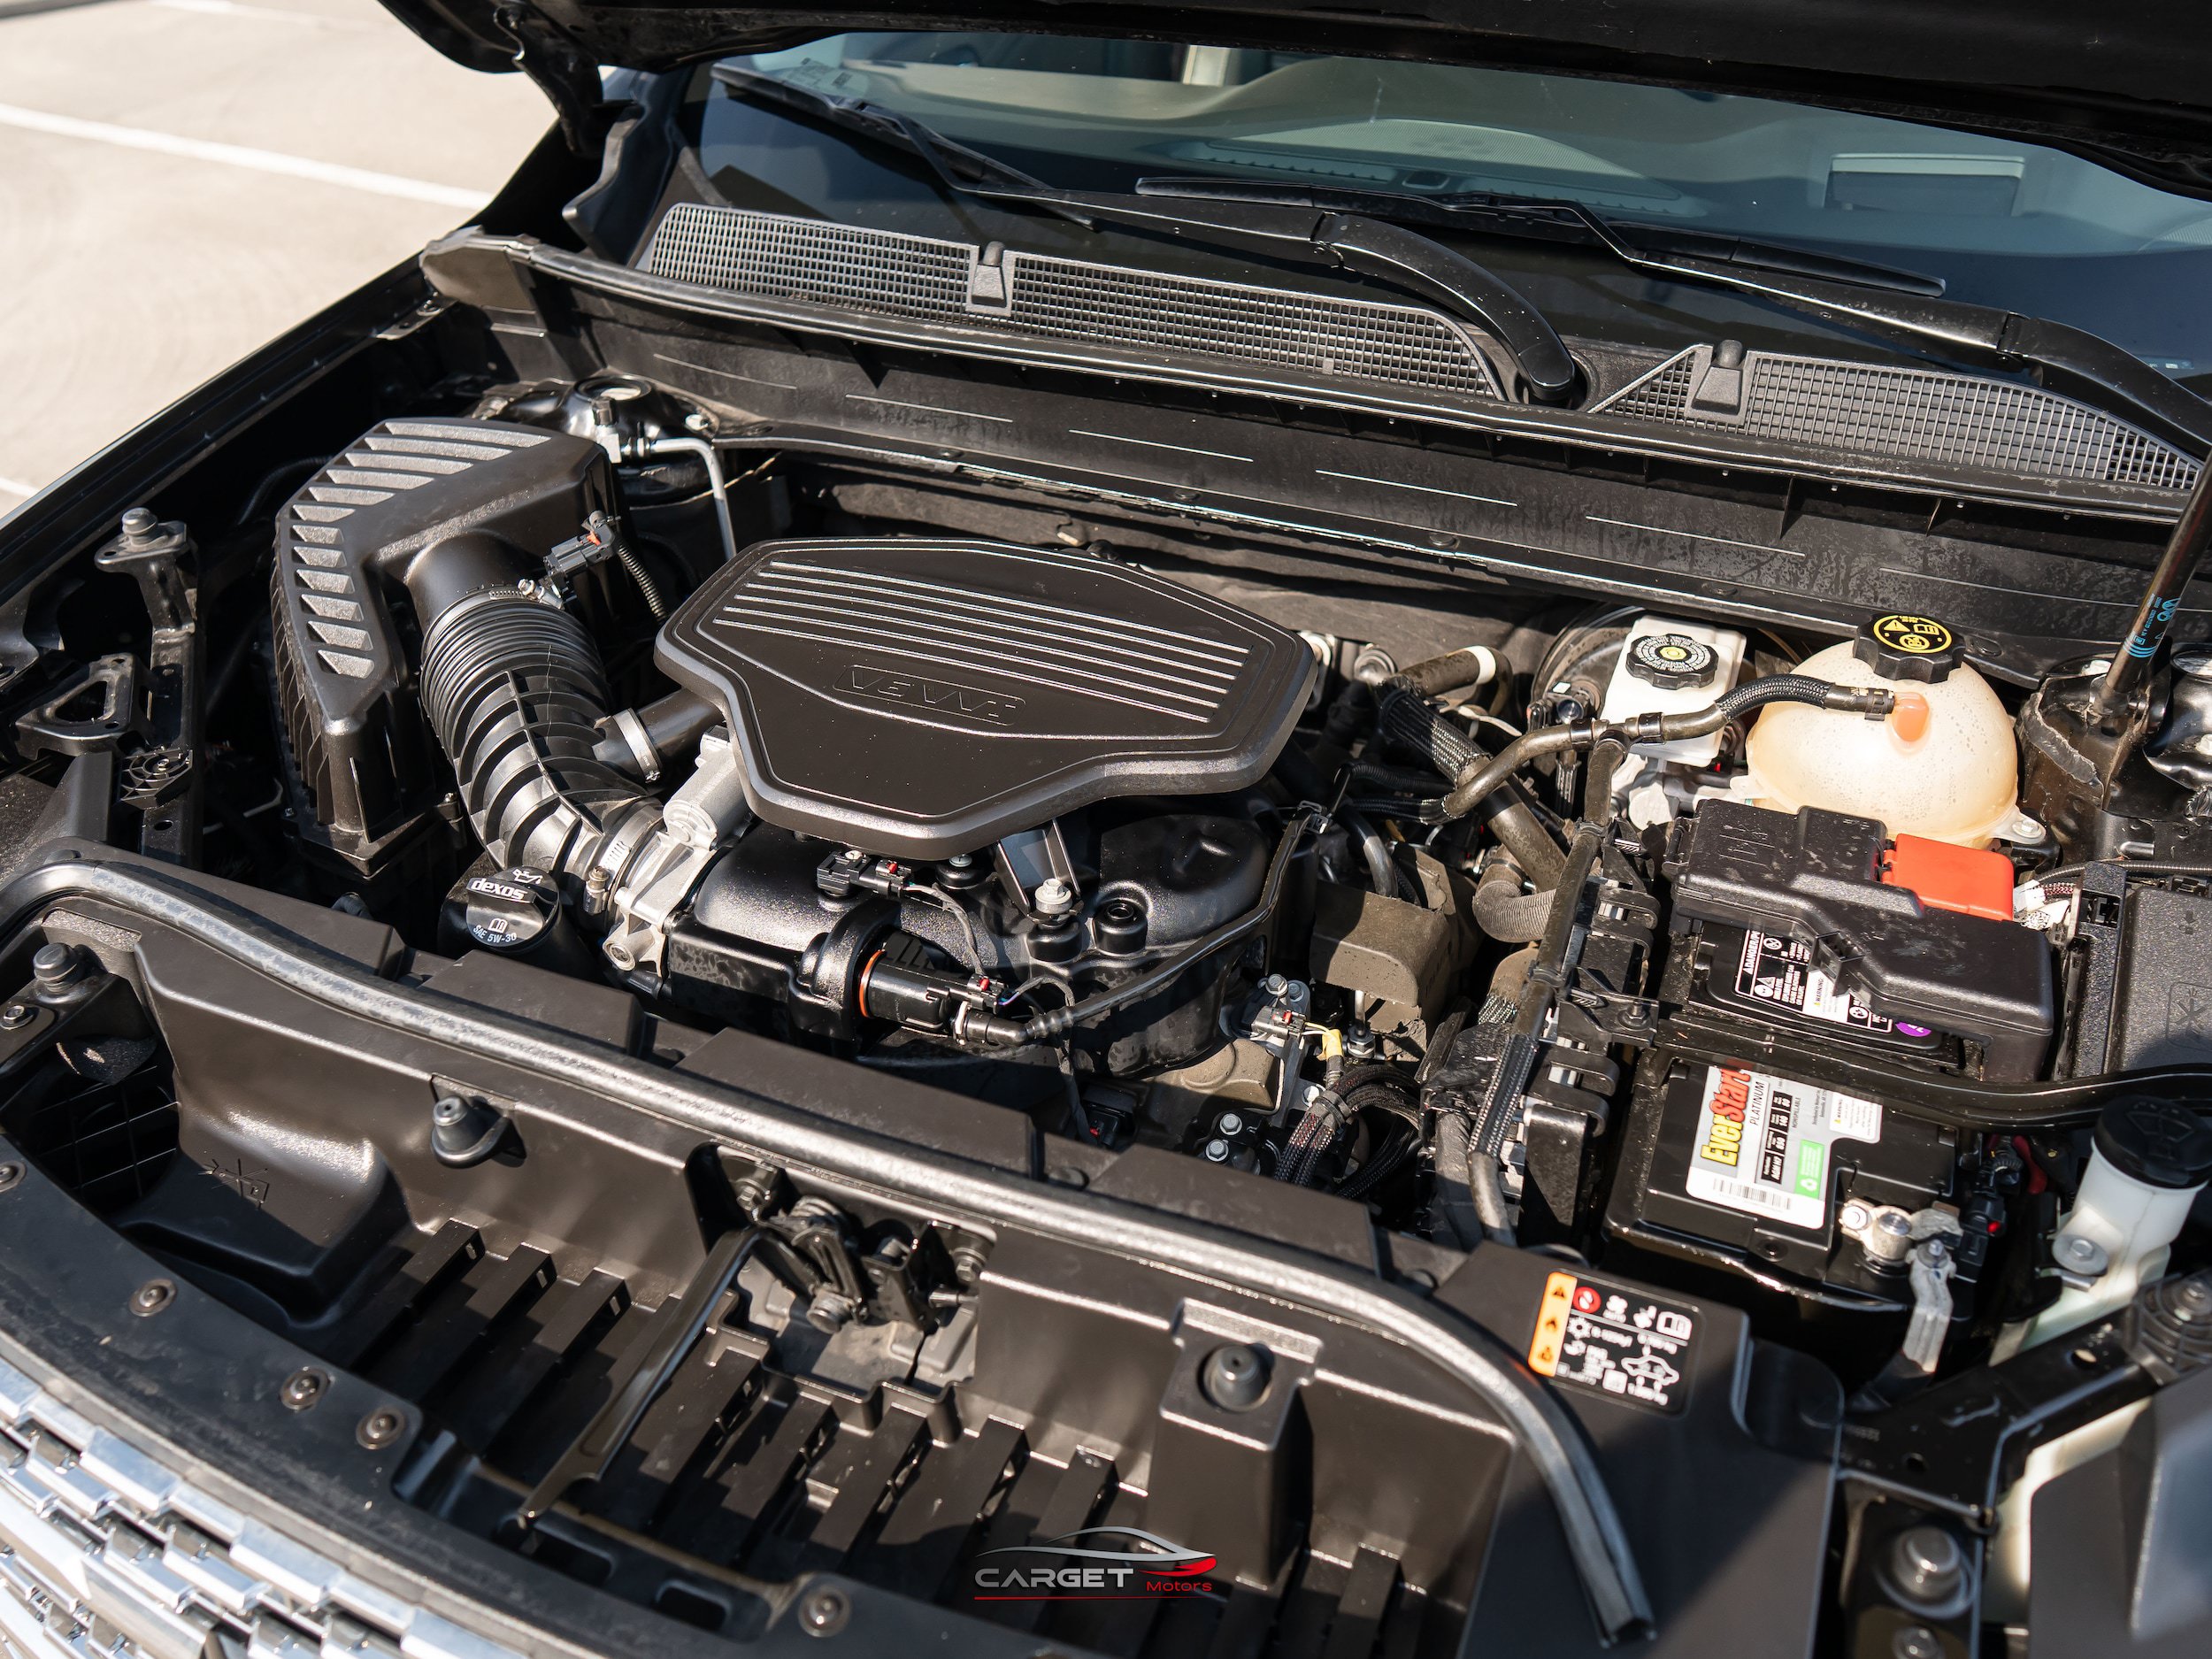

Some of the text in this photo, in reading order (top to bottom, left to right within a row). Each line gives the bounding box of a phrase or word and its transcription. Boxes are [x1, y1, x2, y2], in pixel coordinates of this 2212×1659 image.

[472, 879, 528, 900] dexos
[472, 925, 518, 943] SAE 5W-30
[1700, 1068, 1751, 1167] EverStart
[1749, 1081, 1765, 1125] PLATINUM
